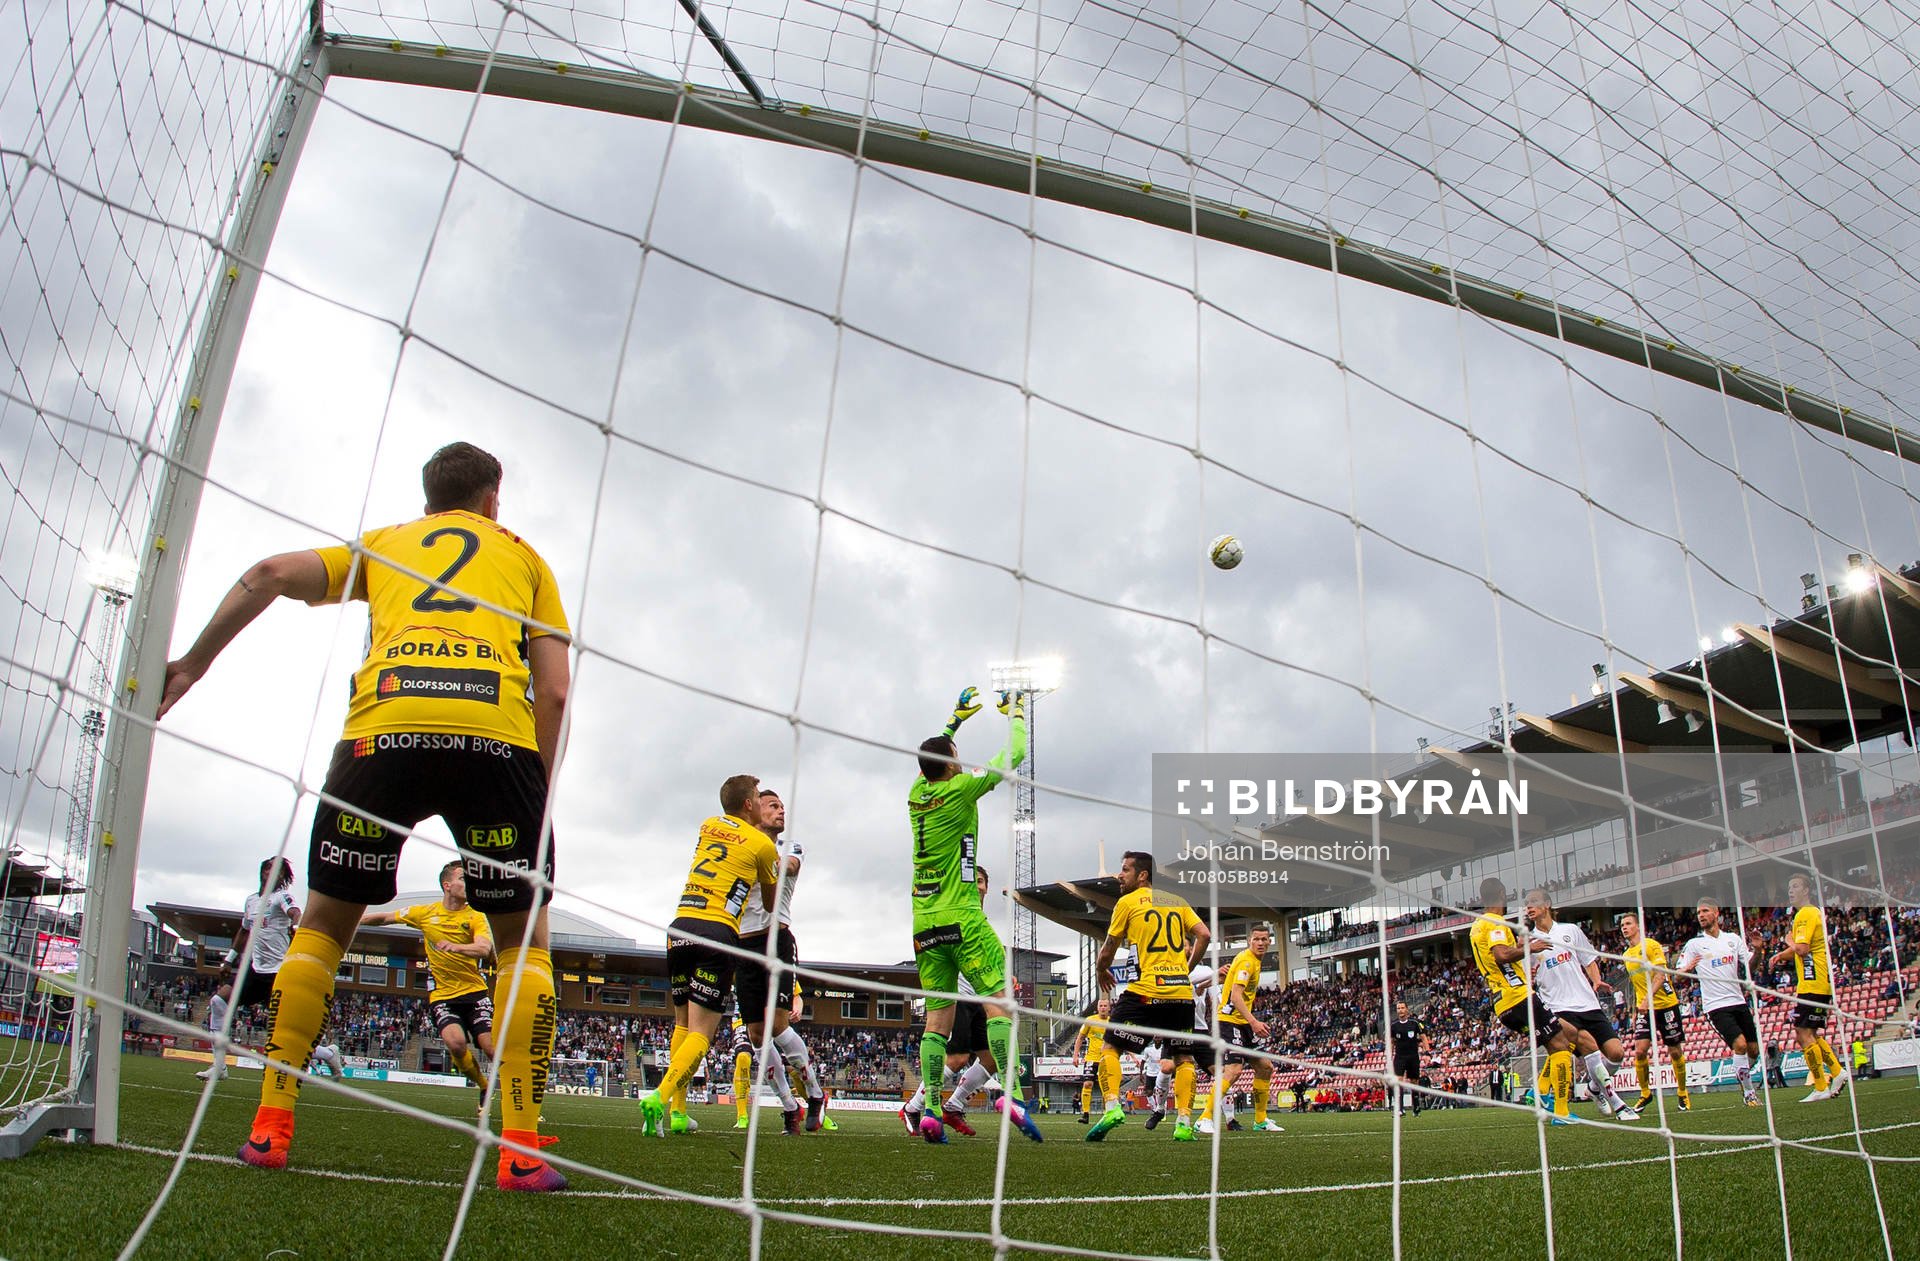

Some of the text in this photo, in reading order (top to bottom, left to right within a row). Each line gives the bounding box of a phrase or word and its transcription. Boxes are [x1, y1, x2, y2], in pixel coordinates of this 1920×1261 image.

[412, 528, 480, 613] 2
[386, 639, 468, 659] BORÅS
[402, 680, 495, 695] OLOFSSON BYGG
[378, 734, 512, 759] OLOFSSON BYGG
[341, 814, 382, 838] EAB
[471, 828, 513, 847] EAB
[320, 841, 397, 871] Cernera
[476, 888, 514, 899] umbro
[1144, 909, 1184, 953] 20
[1546, 951, 1572, 969] ELON
[1711, 955, 1733, 968] ELON
[530, 994, 555, 1104] SPRINGYARD
[510, 1077, 523, 1111] umbro
